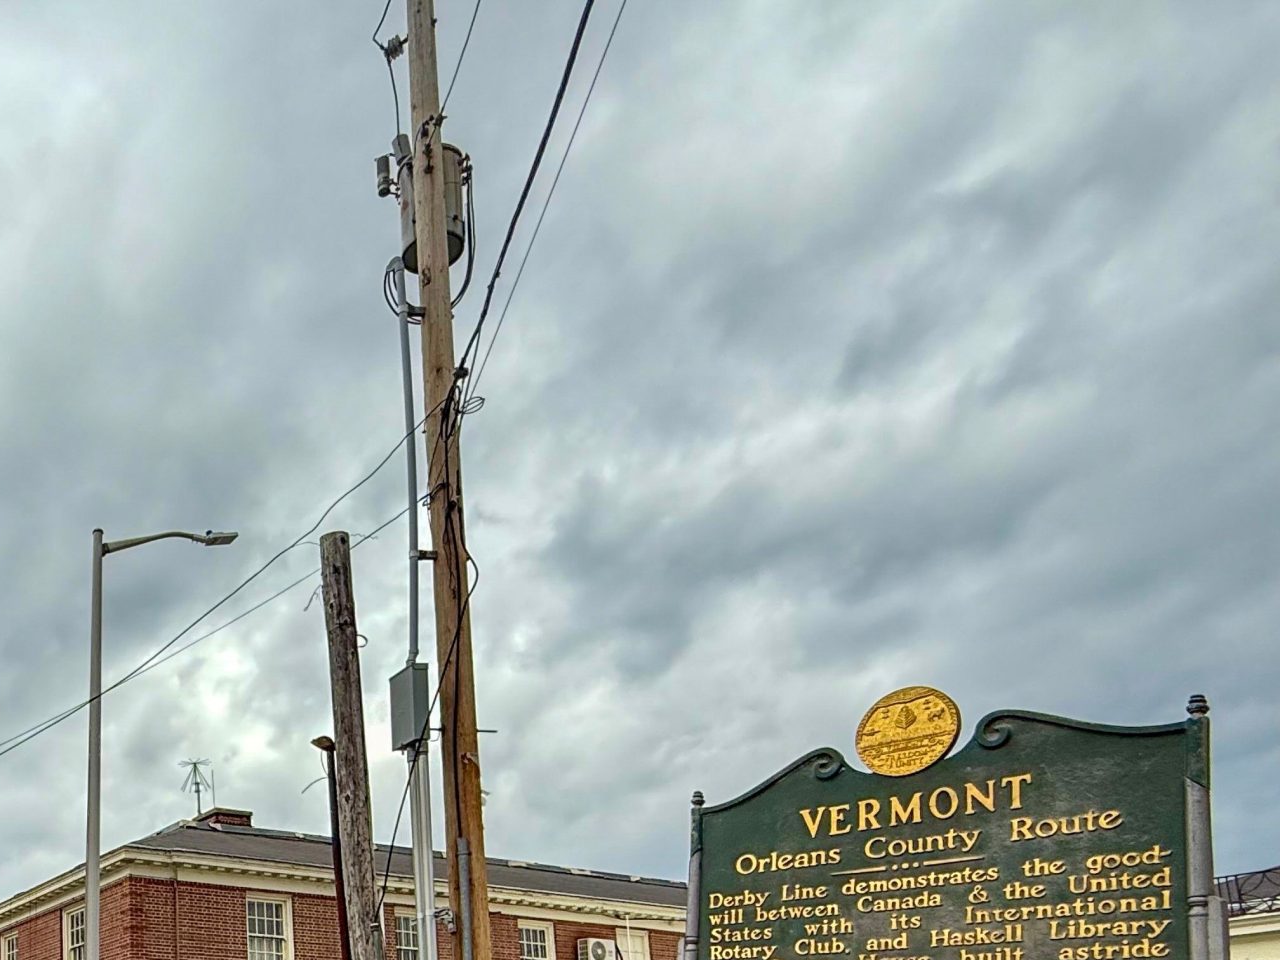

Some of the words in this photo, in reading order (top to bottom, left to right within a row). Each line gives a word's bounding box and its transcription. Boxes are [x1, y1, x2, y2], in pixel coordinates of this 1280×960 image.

[799, 774, 1031, 838] VERMONT
[734, 847, 840, 876] Orleans
[863, 829, 980, 859] County
[1010, 809, 1123, 842] Route
[709, 891, 769, 911] Derby
[781, 884, 827, 901] Line
[841, 866, 998, 896] demonstrates
[1021, 858, 1065, 877] the
[709, 908, 742, 925] will
[755, 901, 839, 923] between
[856, 892, 941, 913] Canada
[968, 885, 988, 903] &
[1003, 881, 1046, 899] the
[1068, 870, 1171, 894] United
[709, 925, 773, 943] States
[804, 919, 853, 936] with
[890, 913, 921, 930] its
[965, 892, 1171, 923] International
[866, 933, 908, 951] and
[929, 925, 1022, 947] Haskell
[1049, 917, 1170, 945] Library
[1058, 940, 1169, 960] astride
